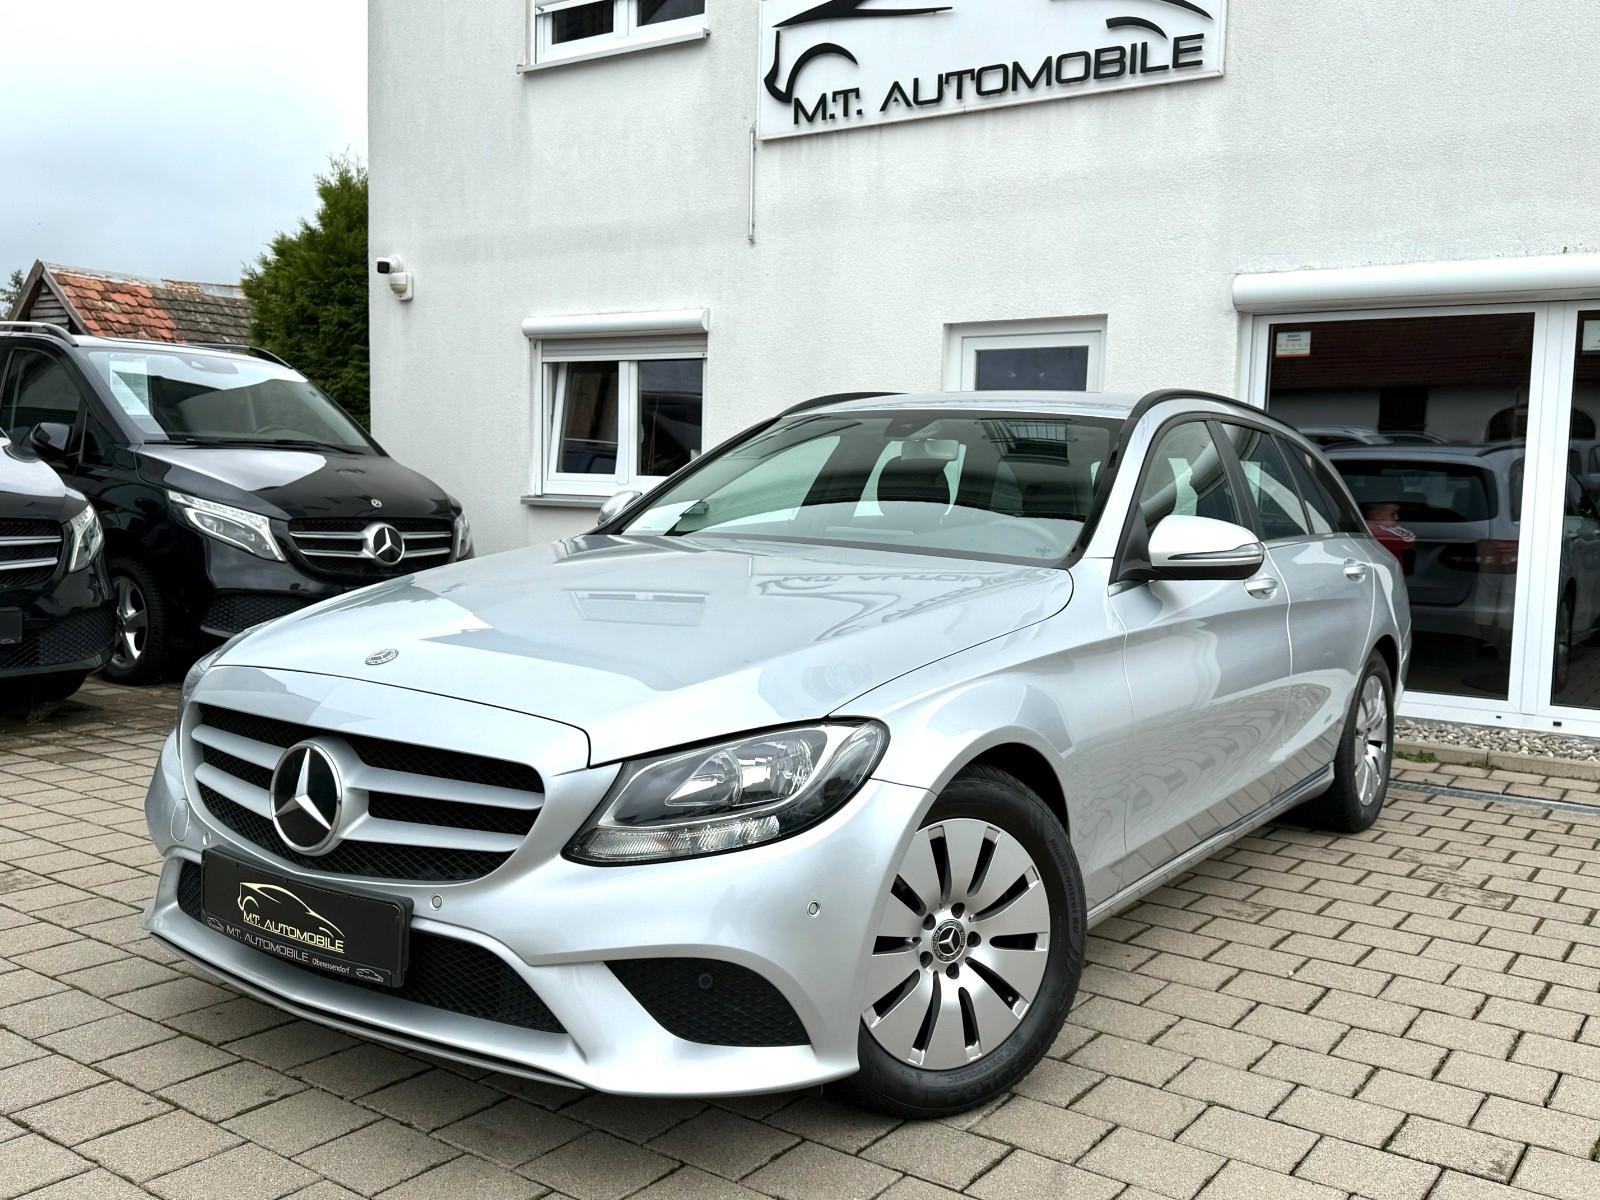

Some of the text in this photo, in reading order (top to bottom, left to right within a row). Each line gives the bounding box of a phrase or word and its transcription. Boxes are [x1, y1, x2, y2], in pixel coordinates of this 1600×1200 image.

[793, 33, 1206, 126] M.T. AUTOMOBILE
[244, 933, 309, 963] AUTOMOBILE
[264, 919, 345, 952] AUTOMOBILE
